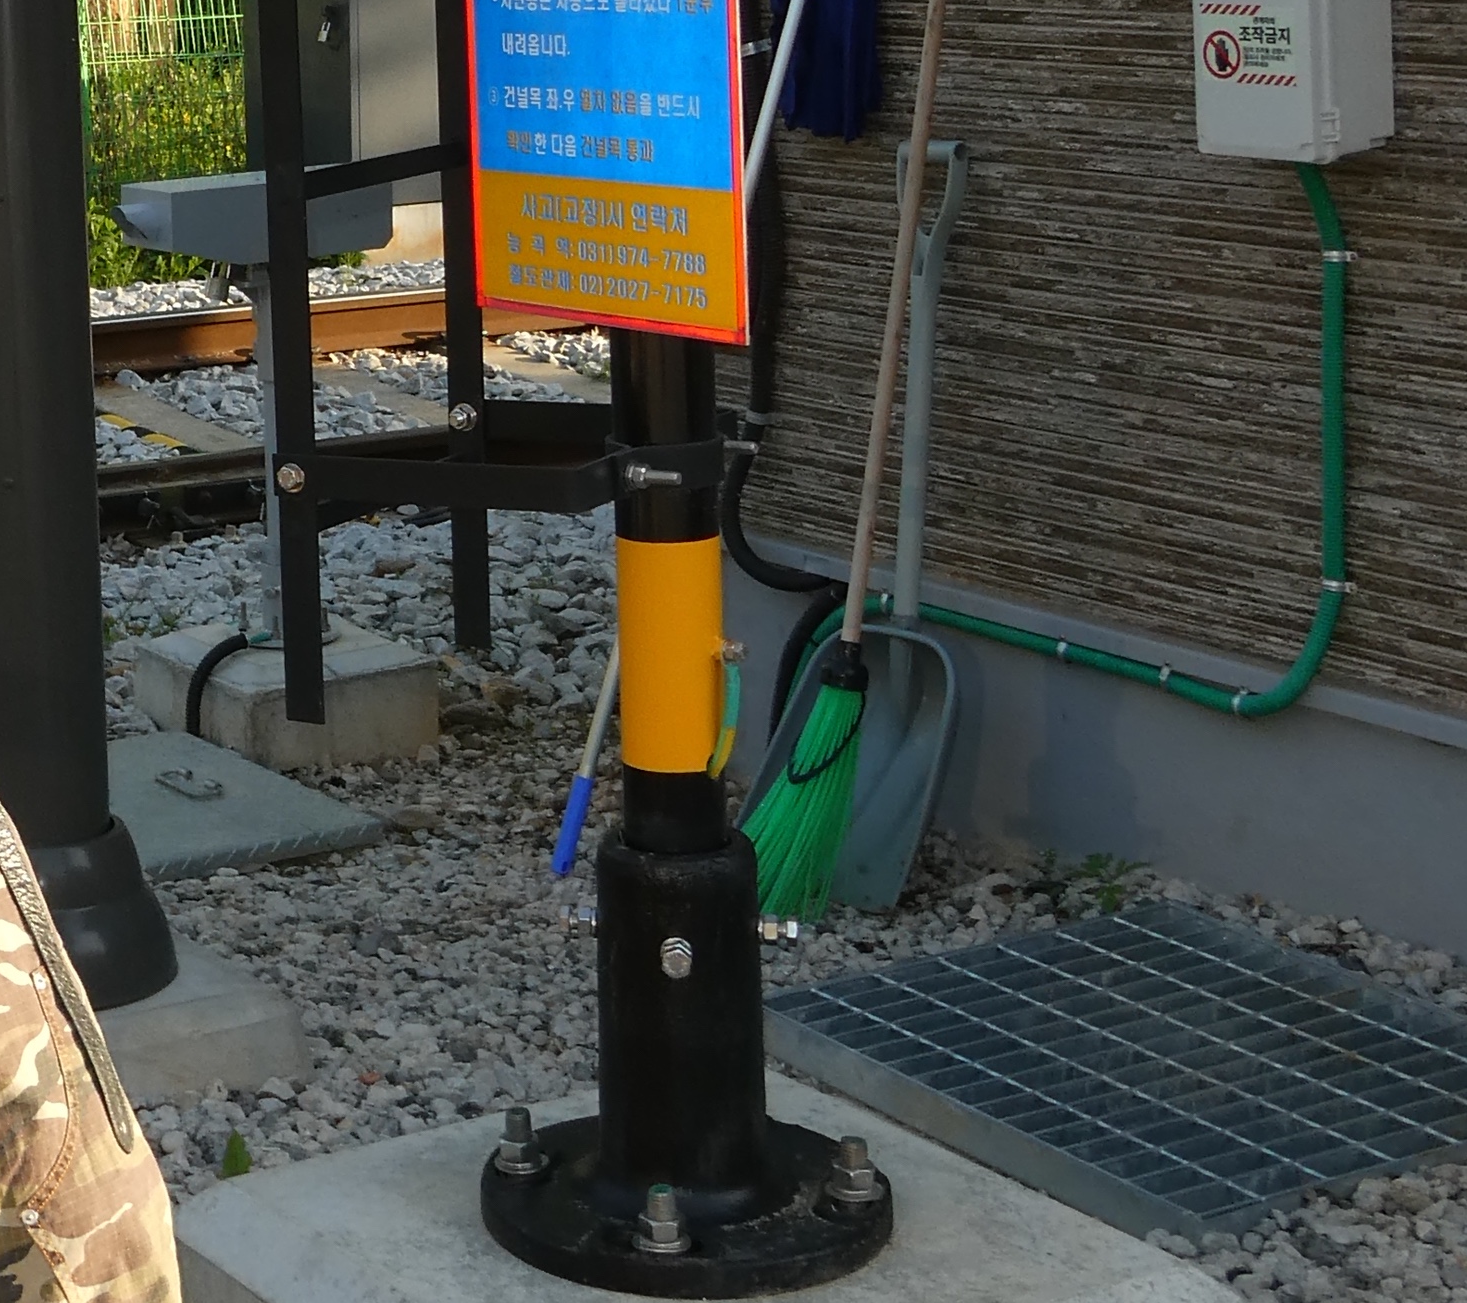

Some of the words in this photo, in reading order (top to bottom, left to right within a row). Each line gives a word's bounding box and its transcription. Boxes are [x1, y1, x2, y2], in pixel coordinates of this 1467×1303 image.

[501, 32, 571, 56] 내려옵니다.
[1238, 26, 1291, 45] 조작금지
[504, 85, 542, 110] 건널목
[657, 93, 700, 120] 반드시
[506, 129, 547, 156] 확인한
[551, 134, 577, 157] 다음
[581, 135, 622, 160] 건널목
[626, 138, 654, 163] 통과
[631, 202, 688, 237] 연락처
